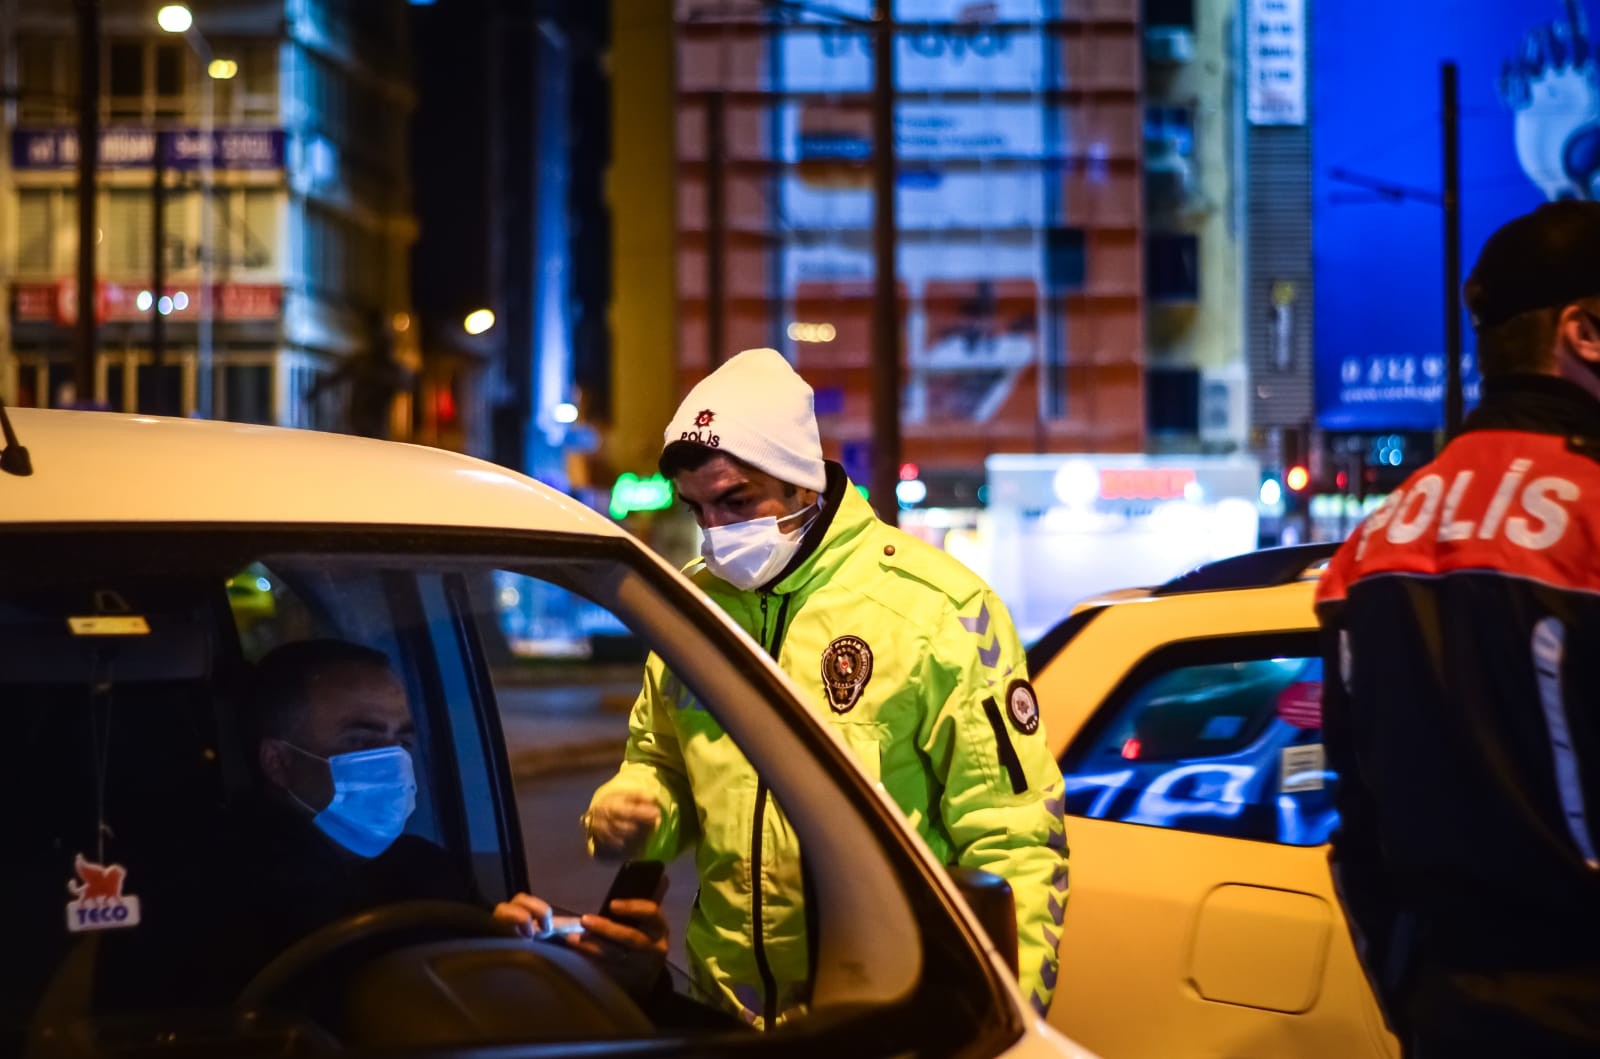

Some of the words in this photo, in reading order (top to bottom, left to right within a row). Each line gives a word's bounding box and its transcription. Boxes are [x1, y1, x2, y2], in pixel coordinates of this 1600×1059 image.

[680, 430, 720, 447] POLİS
[1355, 458, 1581, 561] POLİS
[77, 904, 129, 925] TECO
